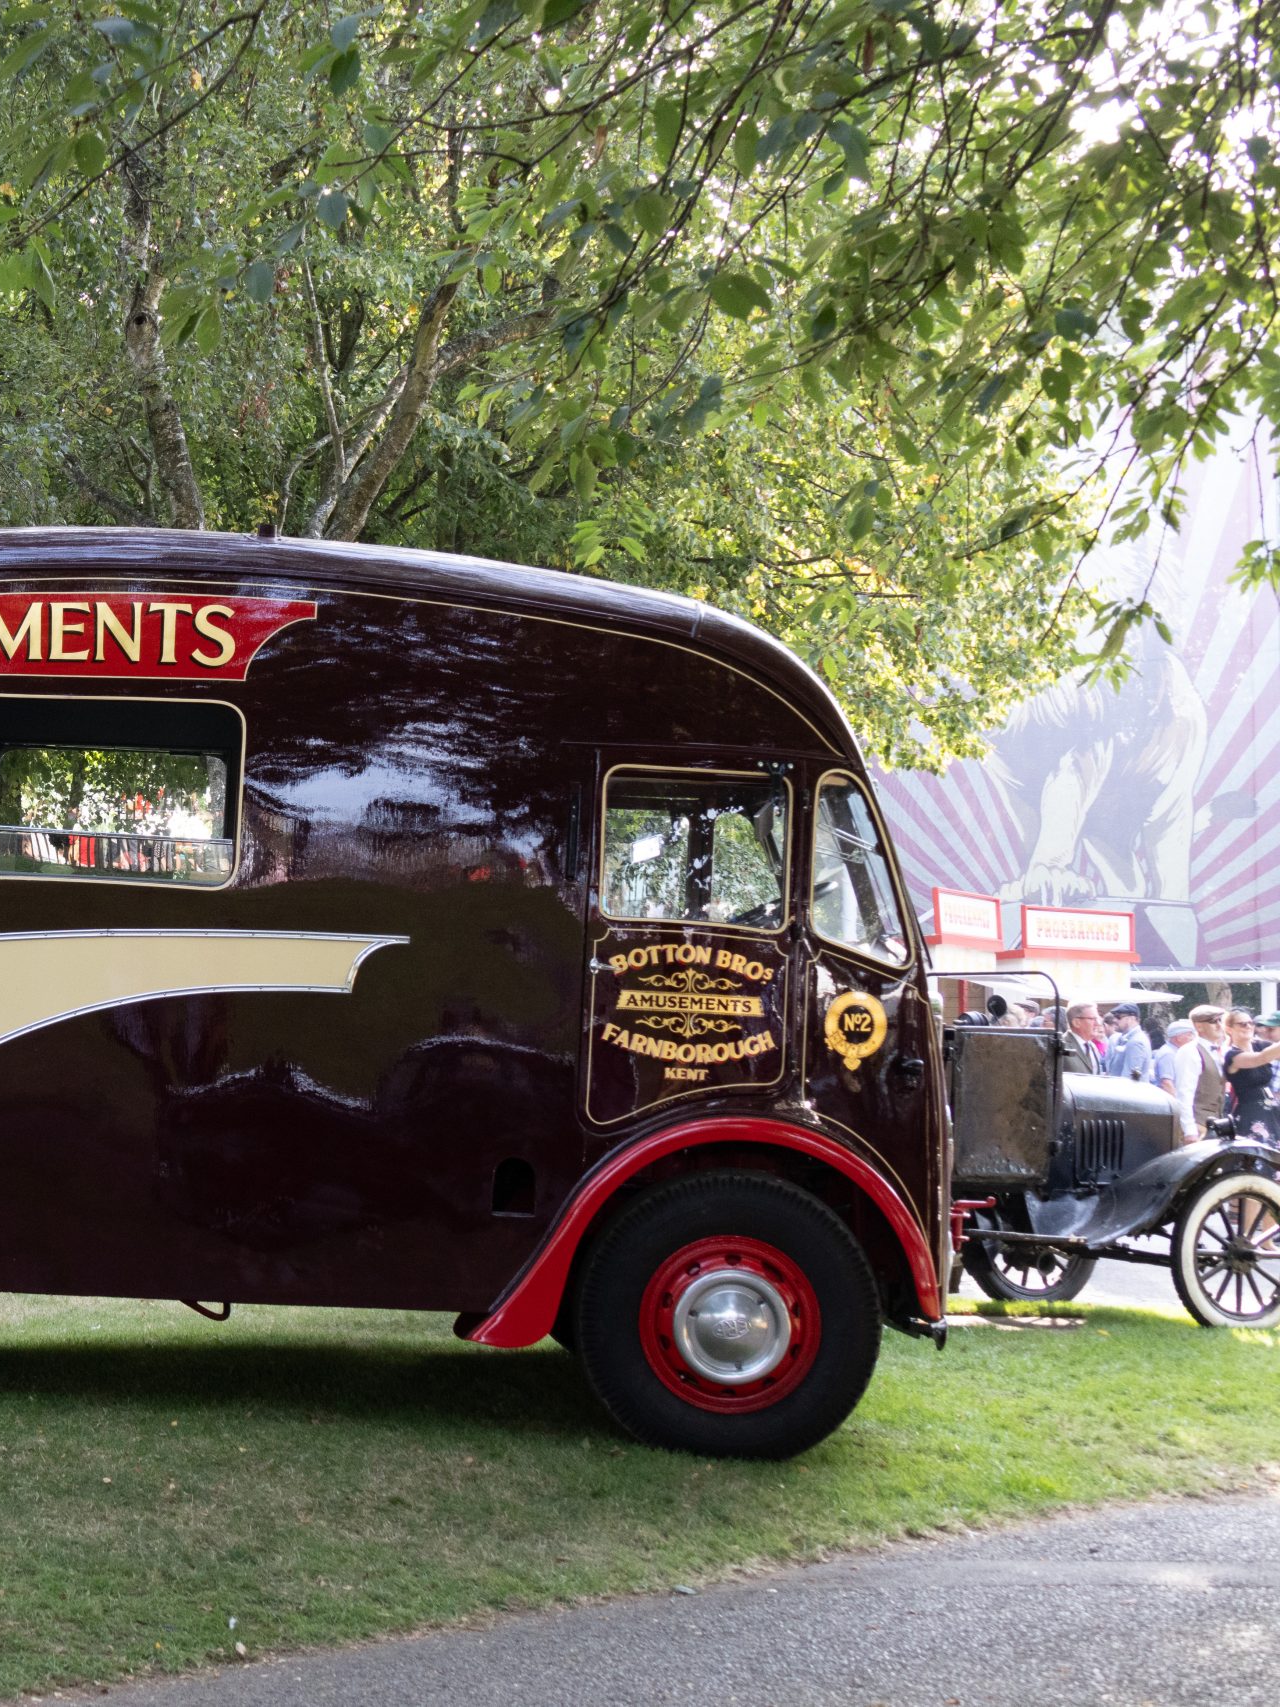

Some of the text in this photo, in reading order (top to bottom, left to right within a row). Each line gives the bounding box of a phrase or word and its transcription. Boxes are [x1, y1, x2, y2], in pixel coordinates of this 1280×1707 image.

[609, 944, 712, 976] BOTTON
[626, 993, 752, 1013] AMUSEMENTS
[601, 1023, 776, 1064] FARNBOROUGH
[664, 1067, 709, 1081] KENT
